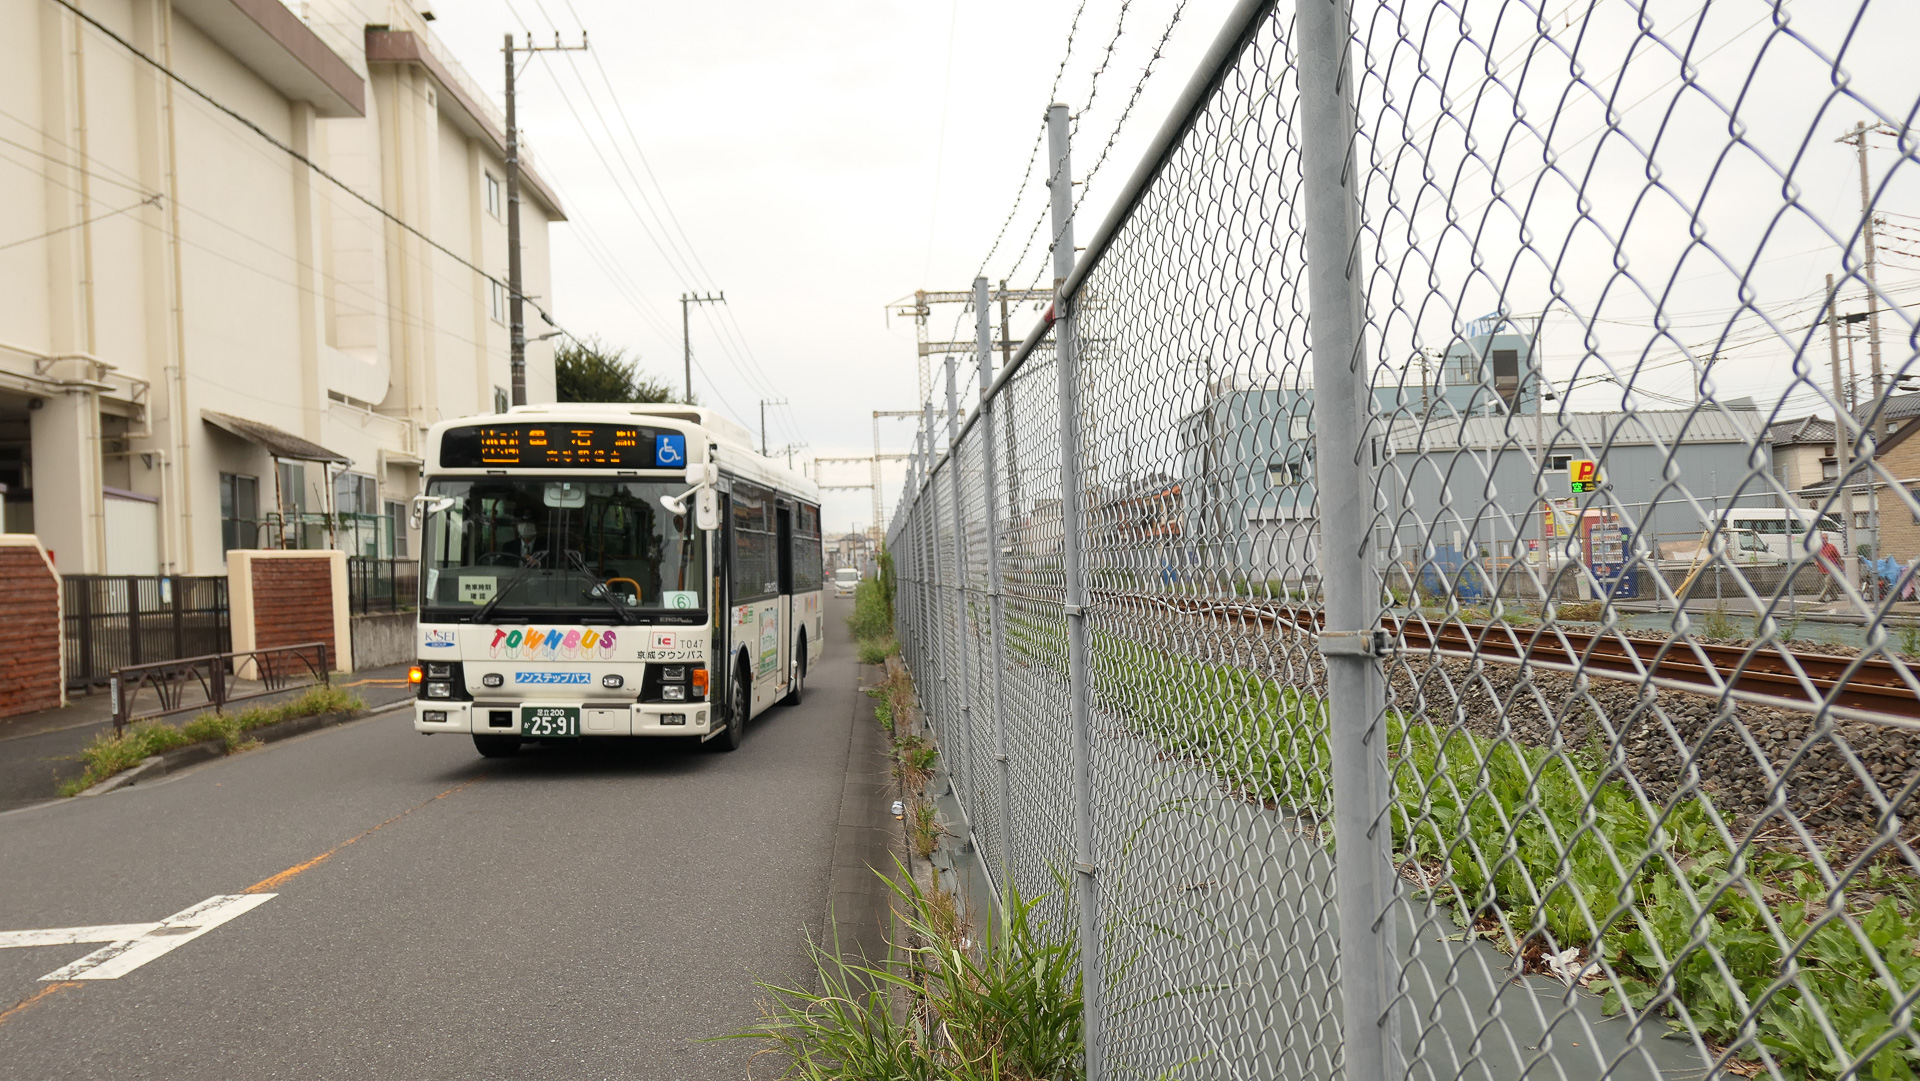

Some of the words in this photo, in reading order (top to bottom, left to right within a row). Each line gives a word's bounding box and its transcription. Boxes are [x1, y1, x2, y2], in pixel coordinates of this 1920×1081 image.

[1578, 462, 1595, 480] P
[637, 651, 704, 660] 京成タウンバス
[516, 673, 590, 683] ノンステップバス
[531, 716, 575, 735] 25-91
